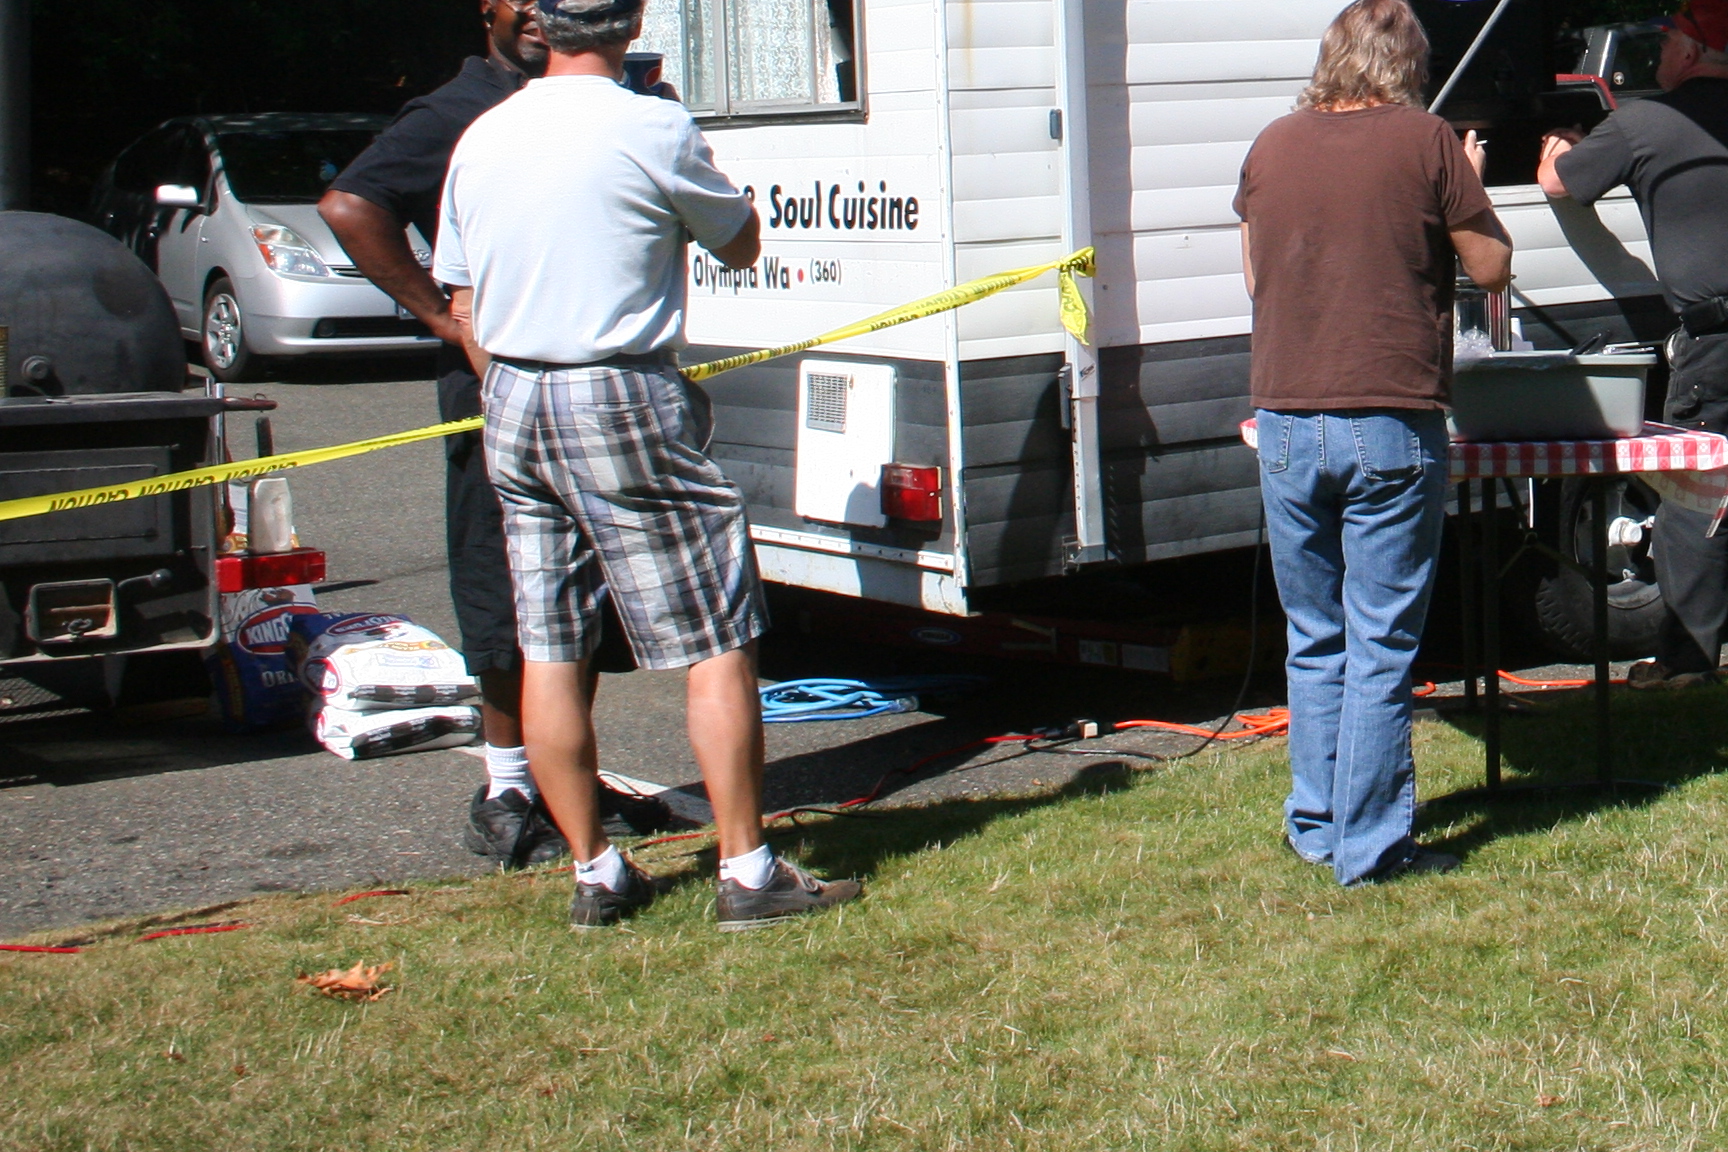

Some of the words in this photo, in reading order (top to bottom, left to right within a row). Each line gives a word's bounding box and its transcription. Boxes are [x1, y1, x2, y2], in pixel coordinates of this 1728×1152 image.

[769, 180, 822, 229] Soul
[828, 180, 920, 230] Cuisine
[693, 252, 759, 296] Olympia
[763, 255, 791, 290] Wa
[810, 258, 842, 286] (360)
